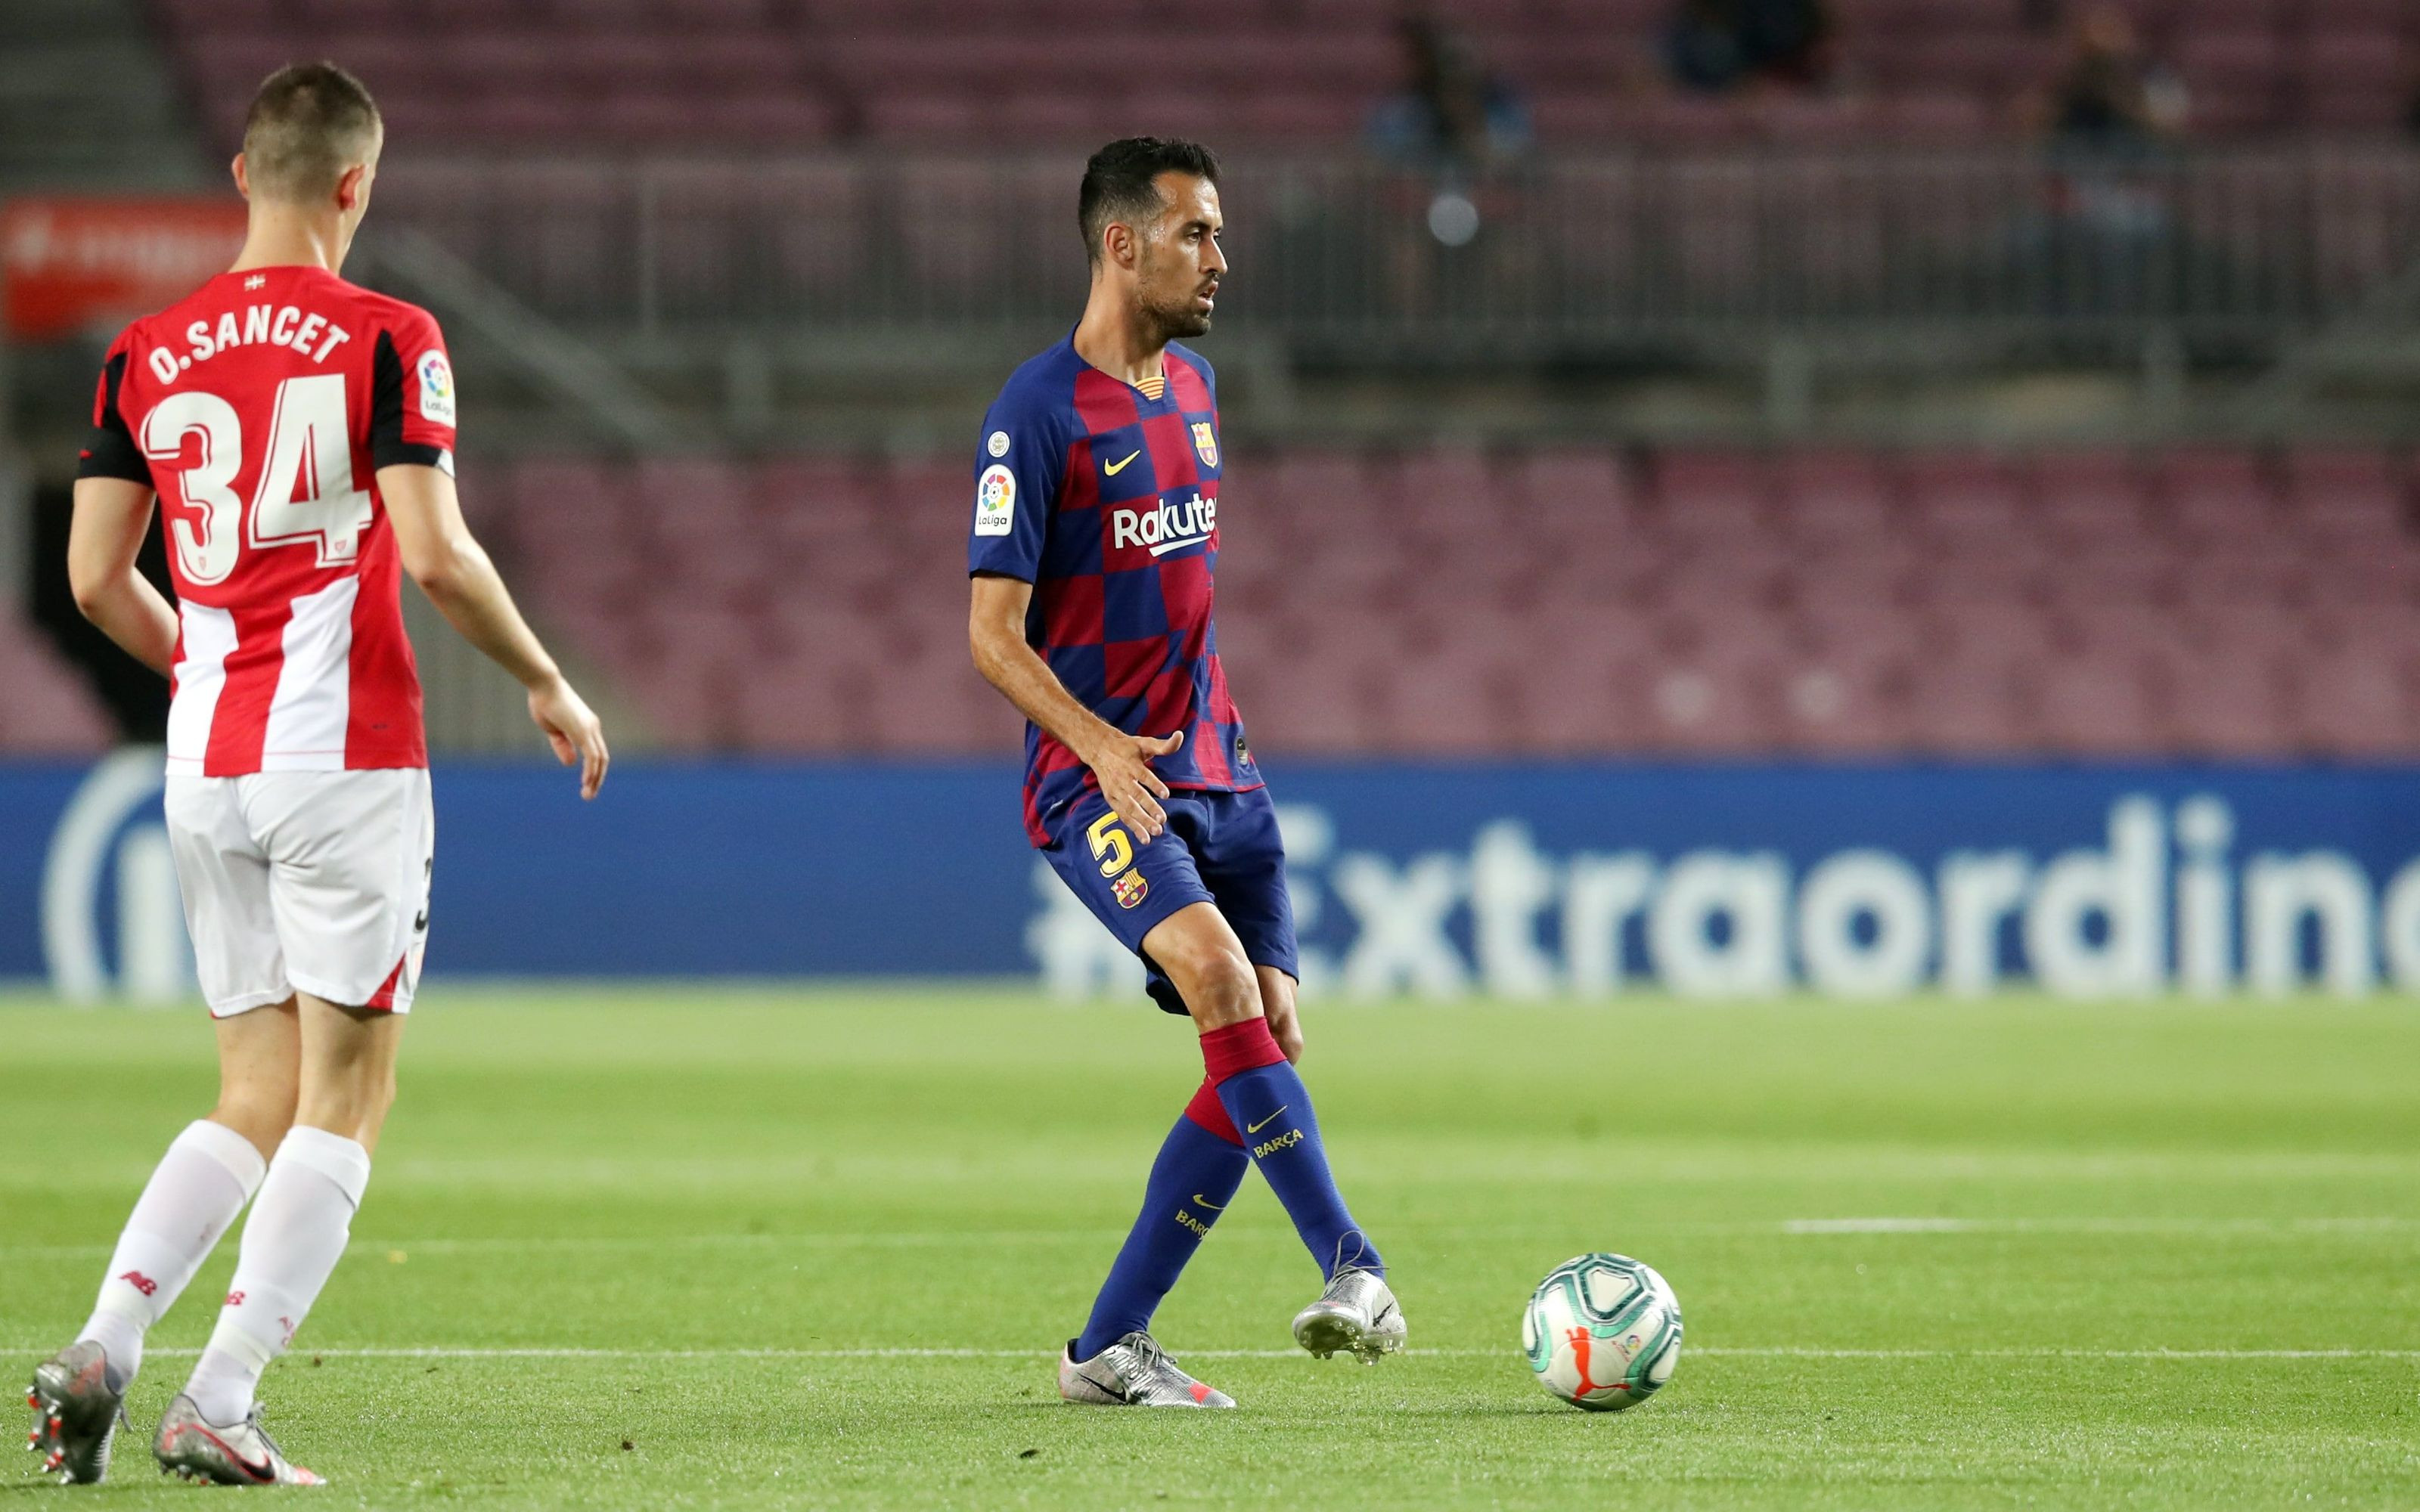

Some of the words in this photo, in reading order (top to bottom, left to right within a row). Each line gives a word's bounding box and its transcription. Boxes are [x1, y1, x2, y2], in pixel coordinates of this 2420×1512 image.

[149, 305, 349, 384] O.SANCET
[139, 373, 373, 586] 34
[979, 514, 1007, 527] LaLiga
[1113, 492, 1218, 550] Rakute
[1086, 811, 1133, 878] 5
[1253, 1129, 1303, 1159] BARÇA
